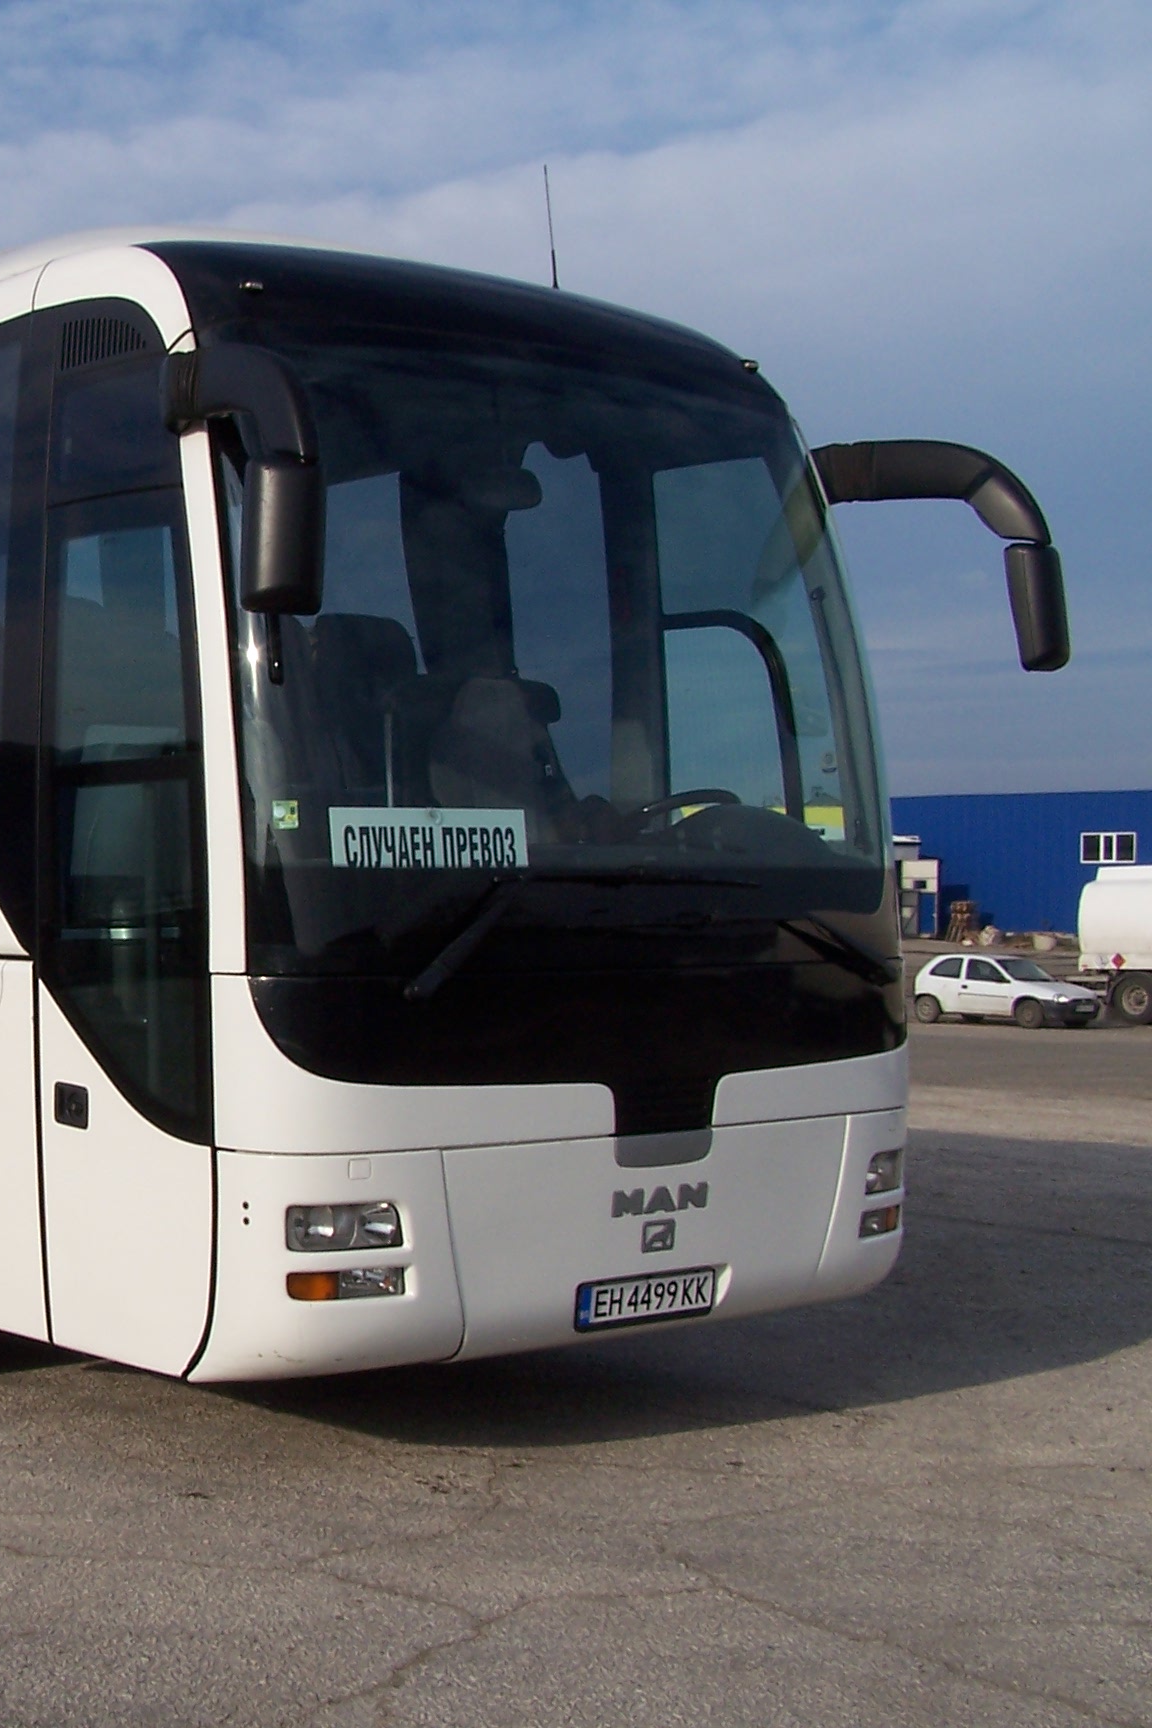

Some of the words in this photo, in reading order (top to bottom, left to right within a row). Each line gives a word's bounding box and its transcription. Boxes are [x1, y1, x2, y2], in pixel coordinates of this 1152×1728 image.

[344, 825, 435, 868] СЛУЧАЕН
[442, 827, 517, 868] ПРЕВОЗ
[611, 1181, 709, 1218] MAN
